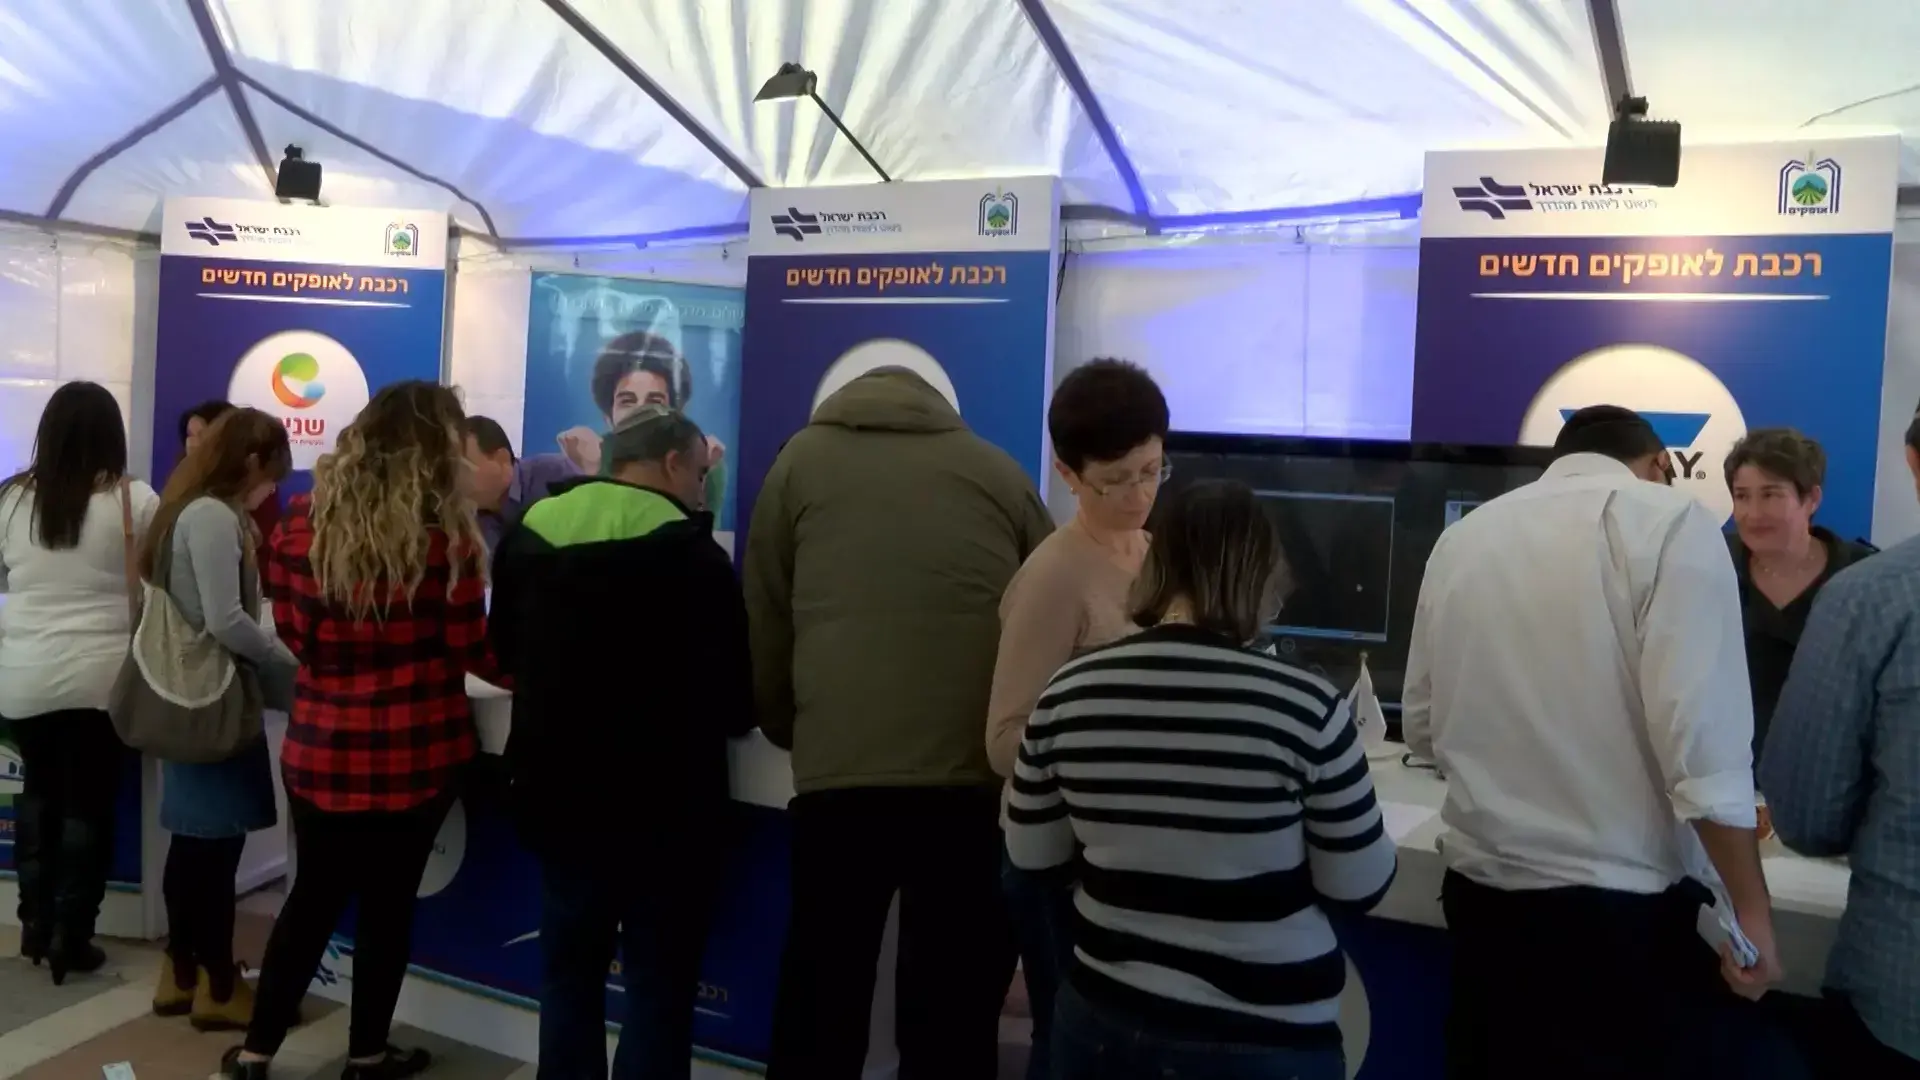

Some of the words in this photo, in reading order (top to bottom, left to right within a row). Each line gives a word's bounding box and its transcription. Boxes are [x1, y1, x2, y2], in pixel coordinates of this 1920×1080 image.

[1529, 182, 1582, 196] ישראל
[1536, 200, 1578, 213] מהדרך
[1788, 207, 1828, 217] אופקים
[819, 212, 853, 222] ישראל
[858, 211, 888, 221] רכבת
[235, 223, 268, 234] ישראל
[1480, 254, 1578, 277] חדשים
[1589, 248, 1723, 284] לאופקים
[1733, 253, 1822, 276] רכבת
[202, 268, 267, 286] חדשים
[273, 270, 354, 291] לאופקים
[786, 268, 850, 287] חדשים
[857, 262, 943, 291] לאופקים
[949, 266, 1006, 285] רכבת
[359, 277, 408, 293] רכבת
[286, 417, 325, 436] שני
